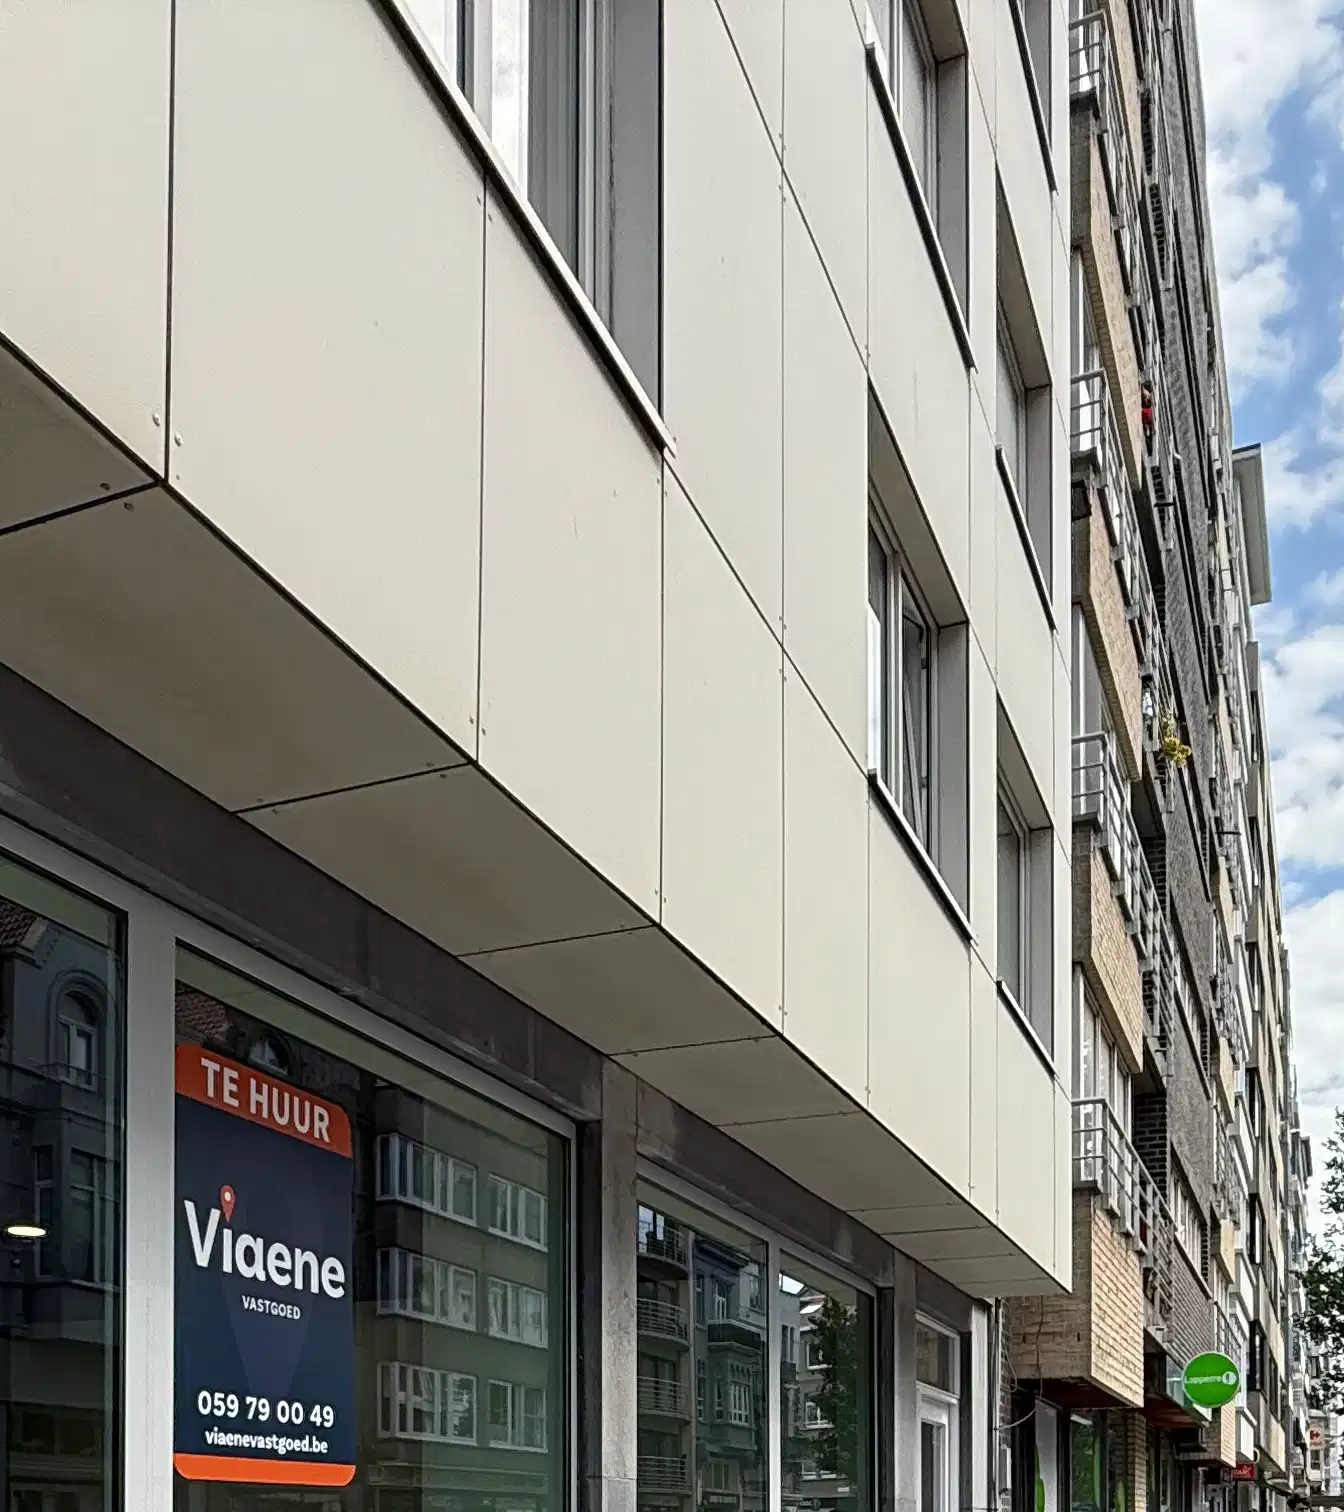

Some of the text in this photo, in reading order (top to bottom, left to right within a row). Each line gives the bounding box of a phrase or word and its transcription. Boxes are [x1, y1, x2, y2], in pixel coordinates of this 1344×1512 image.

[200, 1057, 330, 1143] TE HUUR
[184, 1186, 345, 1298] Viaene
[242, 1294, 301, 1320] VASTGOED
[197, 1390, 334, 1428] 059 79 00 49
[205, 1427, 328, 1455] viaenevastgoed.be
